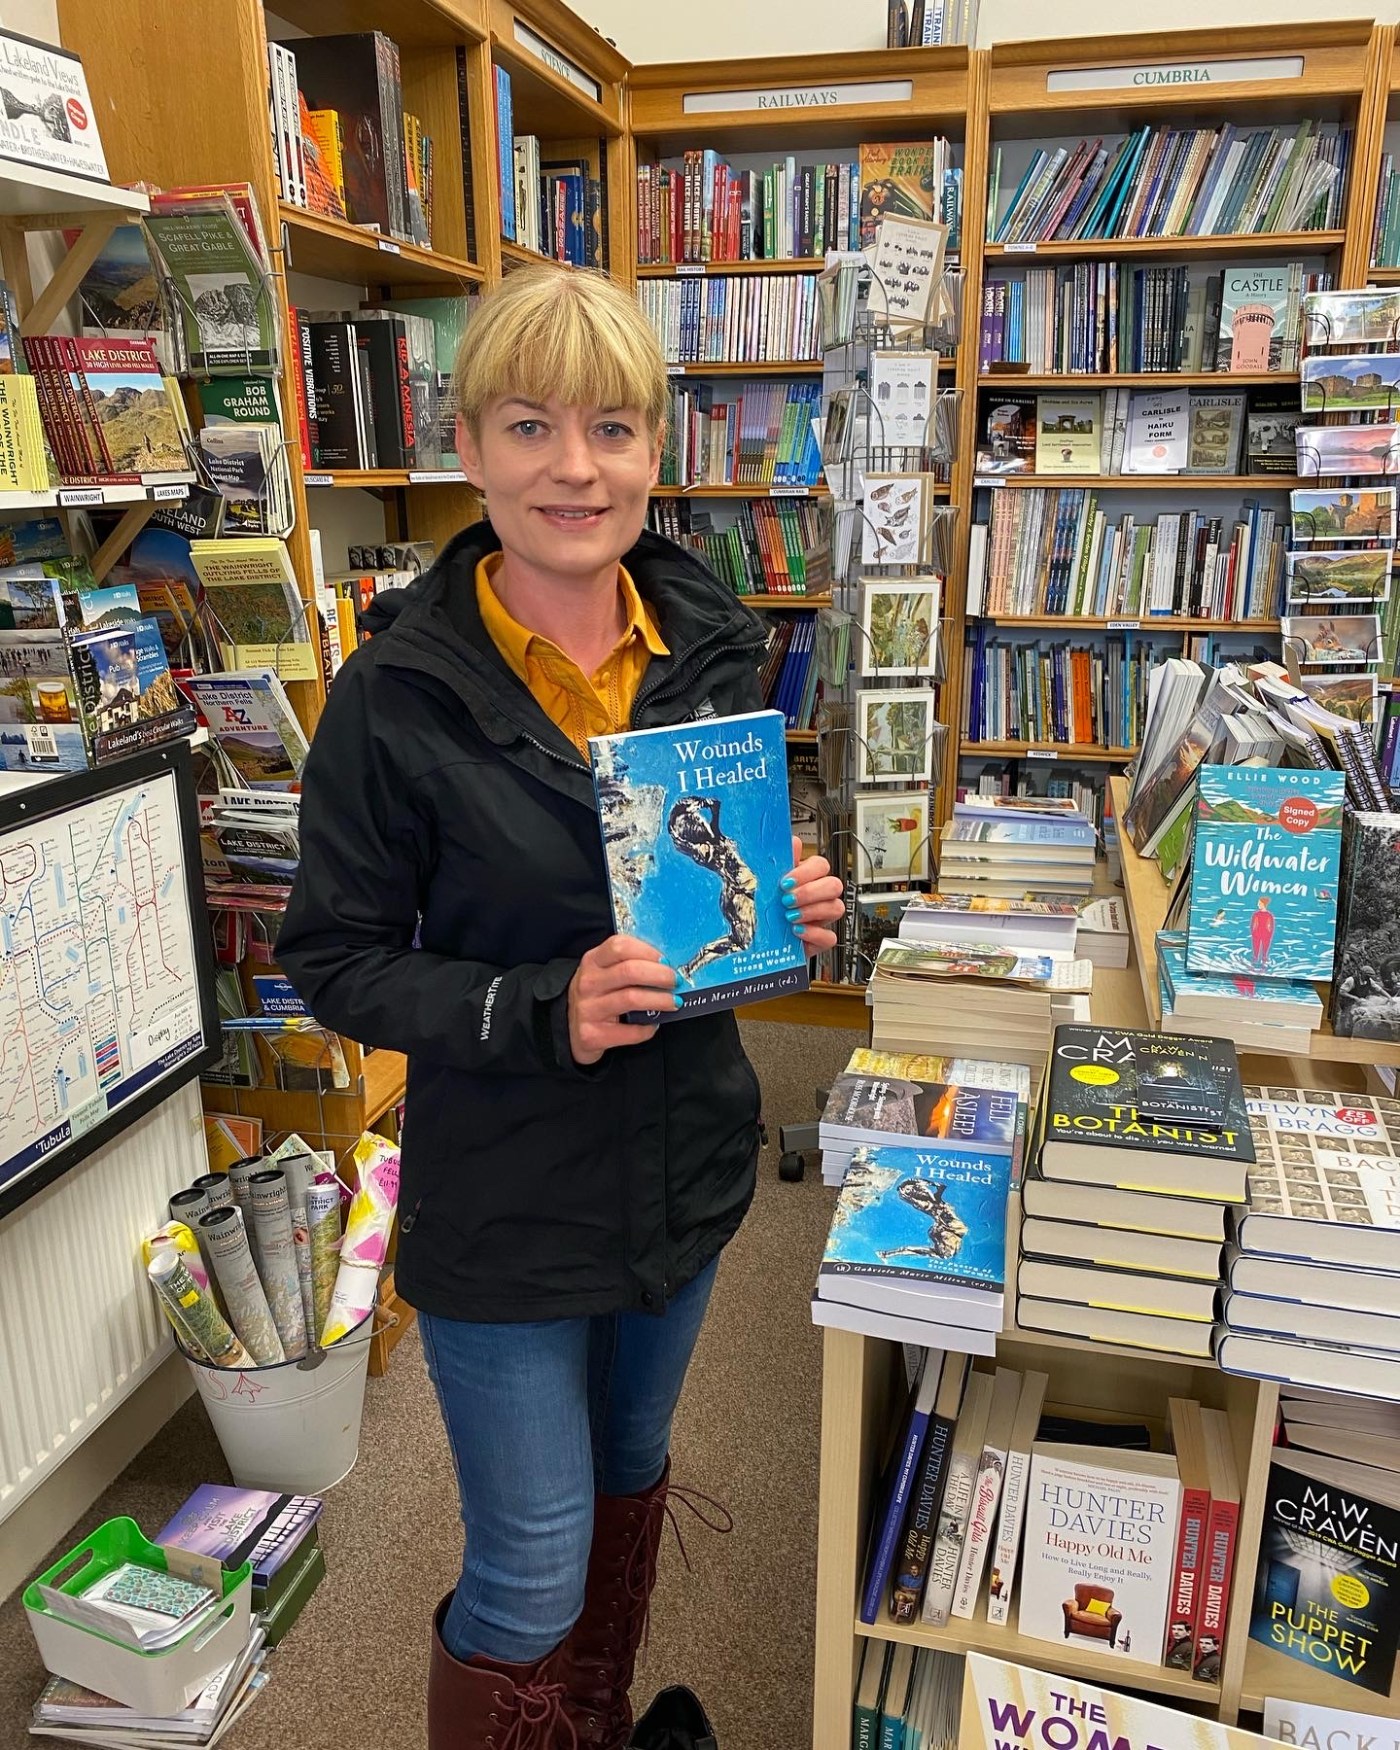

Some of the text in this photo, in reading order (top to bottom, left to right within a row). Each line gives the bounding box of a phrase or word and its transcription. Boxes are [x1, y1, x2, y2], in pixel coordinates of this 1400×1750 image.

[1133, 69, 1211, 86] CUMBRIA
[758, 91, 838, 109] RAILWAYS
[158, 232, 200, 242] SCAFELL
[201, 231, 225, 241] PIKE
[169, 241, 235, 252] GREAT GABLE
[1231, 279, 1283, 292] CASTLE
[82, 350, 151, 361] LAKE DISTRICT
[301, 326, 318, 420] POSITIVE VIBRATIONS
[246, 386, 266, 396] BOB
[57, 388, 70, 423] DISTRICT
[67, 388, 80, 422] DISTRICT
[83, 389, 97, 423] DISTRICT
[224, 397, 268, 407] GRAHAM
[1142, 406, 1181, 417] CARLISLE
[1189, 398, 1241, 407] CARLISLE
[234, 407, 270, 417] ROUND
[1147, 422, 1174, 430] HAIKU
[2, 408, 18, 486] WAINWRIGHT
[70, 476, 97, 485] DISTRICT
[64, 494, 100, 503] WAINWRIGHT
[171, 488, 184, 496] MAPS
[176, 520, 202, 536] WEST
[202, 568, 269, 577] OUTLYING FELLS
[222, 562, 274, 571] WAINWRIGHT
[246, 573, 282, 581] DISTRICT
[109, 665, 121, 674] Pub
[196, 690, 253, 700] Lake District
[108, 732, 142, 750] Lakeland's
[673, 732, 763, 764] Wounds
[678, 758, 767, 793] I Healed
[1227, 772, 1321, 786] ELLIE WOOD
[1284, 806, 1315, 817] Signed
[1286, 816, 1310, 827] Copy
[220, 838, 286, 851] LAKE DISTRICT
[1256, 828, 1282, 842] The
[1205, 839, 1330, 873] Wildwater
[1220, 870, 1308, 897] Women
[732, 944, 791, 965] The Poetry of
[733, 955, 796, 975] Strong Women
[711, 975, 798, 1003] Marie Milton (ed.)
[480, 976, 503, 1041] WEATHERTITE
[1157, 1034, 1186, 1042] Dagger
[1140, 1047, 1195, 1057] CRAVEN
[952, 1090, 981, 1136] ASLEEP
[989, 1094, 1013, 1123] FELL
[1245, 1102, 1338, 1120] MELVYN
[1345, 1110, 1367, 1118] £5
[1053, 1113, 1239, 1145] BOTANIST
[1279, 1117, 1378, 1137] BRAGG
[1343, 1117, 1371, 1126] OFF
[1056, 1127, 1083, 1136] You're
[1086, 1131, 1112, 1139] about
[1157, 1138, 1174, 1146] you
[917, 1154, 992, 1172] Wounds
[915, 1167, 992, 1185] I Healed
[854, 1266, 967, 1285] Gabriela Marie Milton
[915, 1423, 949, 1531] HUNTER DAVIES
[945, 1474, 960, 1513] THE DAY
[954, 1480, 970, 1516] LIFE IN
[1001, 1455, 1024, 1543] HUNTER DAVIES
[1040, 1482, 1166, 1524] HUNTER
[1303, 1486, 1373, 1529] M.W.
[1050, 1507, 1152, 1545] DAVIES
[1275, 1499, 1398, 1561] CRAVEN
[909, 1529, 918, 1543] Old
[918, 1534, 931, 1562] Happy
[967, 1523, 989, 1573] Girls Hunter
[1045, 1531, 1153, 1565] Happy Old Me
[1323, 1535, 1398, 1569] CWA Gold Dagger Award
[932, 1547, 947, 1584] DAVIES
[942, 1546, 959, 1590] HUNTER
[1042, 1552, 1152, 1581] How to Live Long and Really,
[1176, 1518, 1201, 1616] HUNTER DAVIES
[1068, 1567, 1092, 1579] Really
[1093, 1572, 1116, 1584] Enjoy
[1204, 1530, 1230, 1629] HUNTER DAVIES
[1308, 1601, 1339, 1624] THE
[1271, 1601, 1373, 1658] PUPPET
[1271, 1623, 1366, 1676] SHOW
[1050, 1691, 1108, 1726] THE
